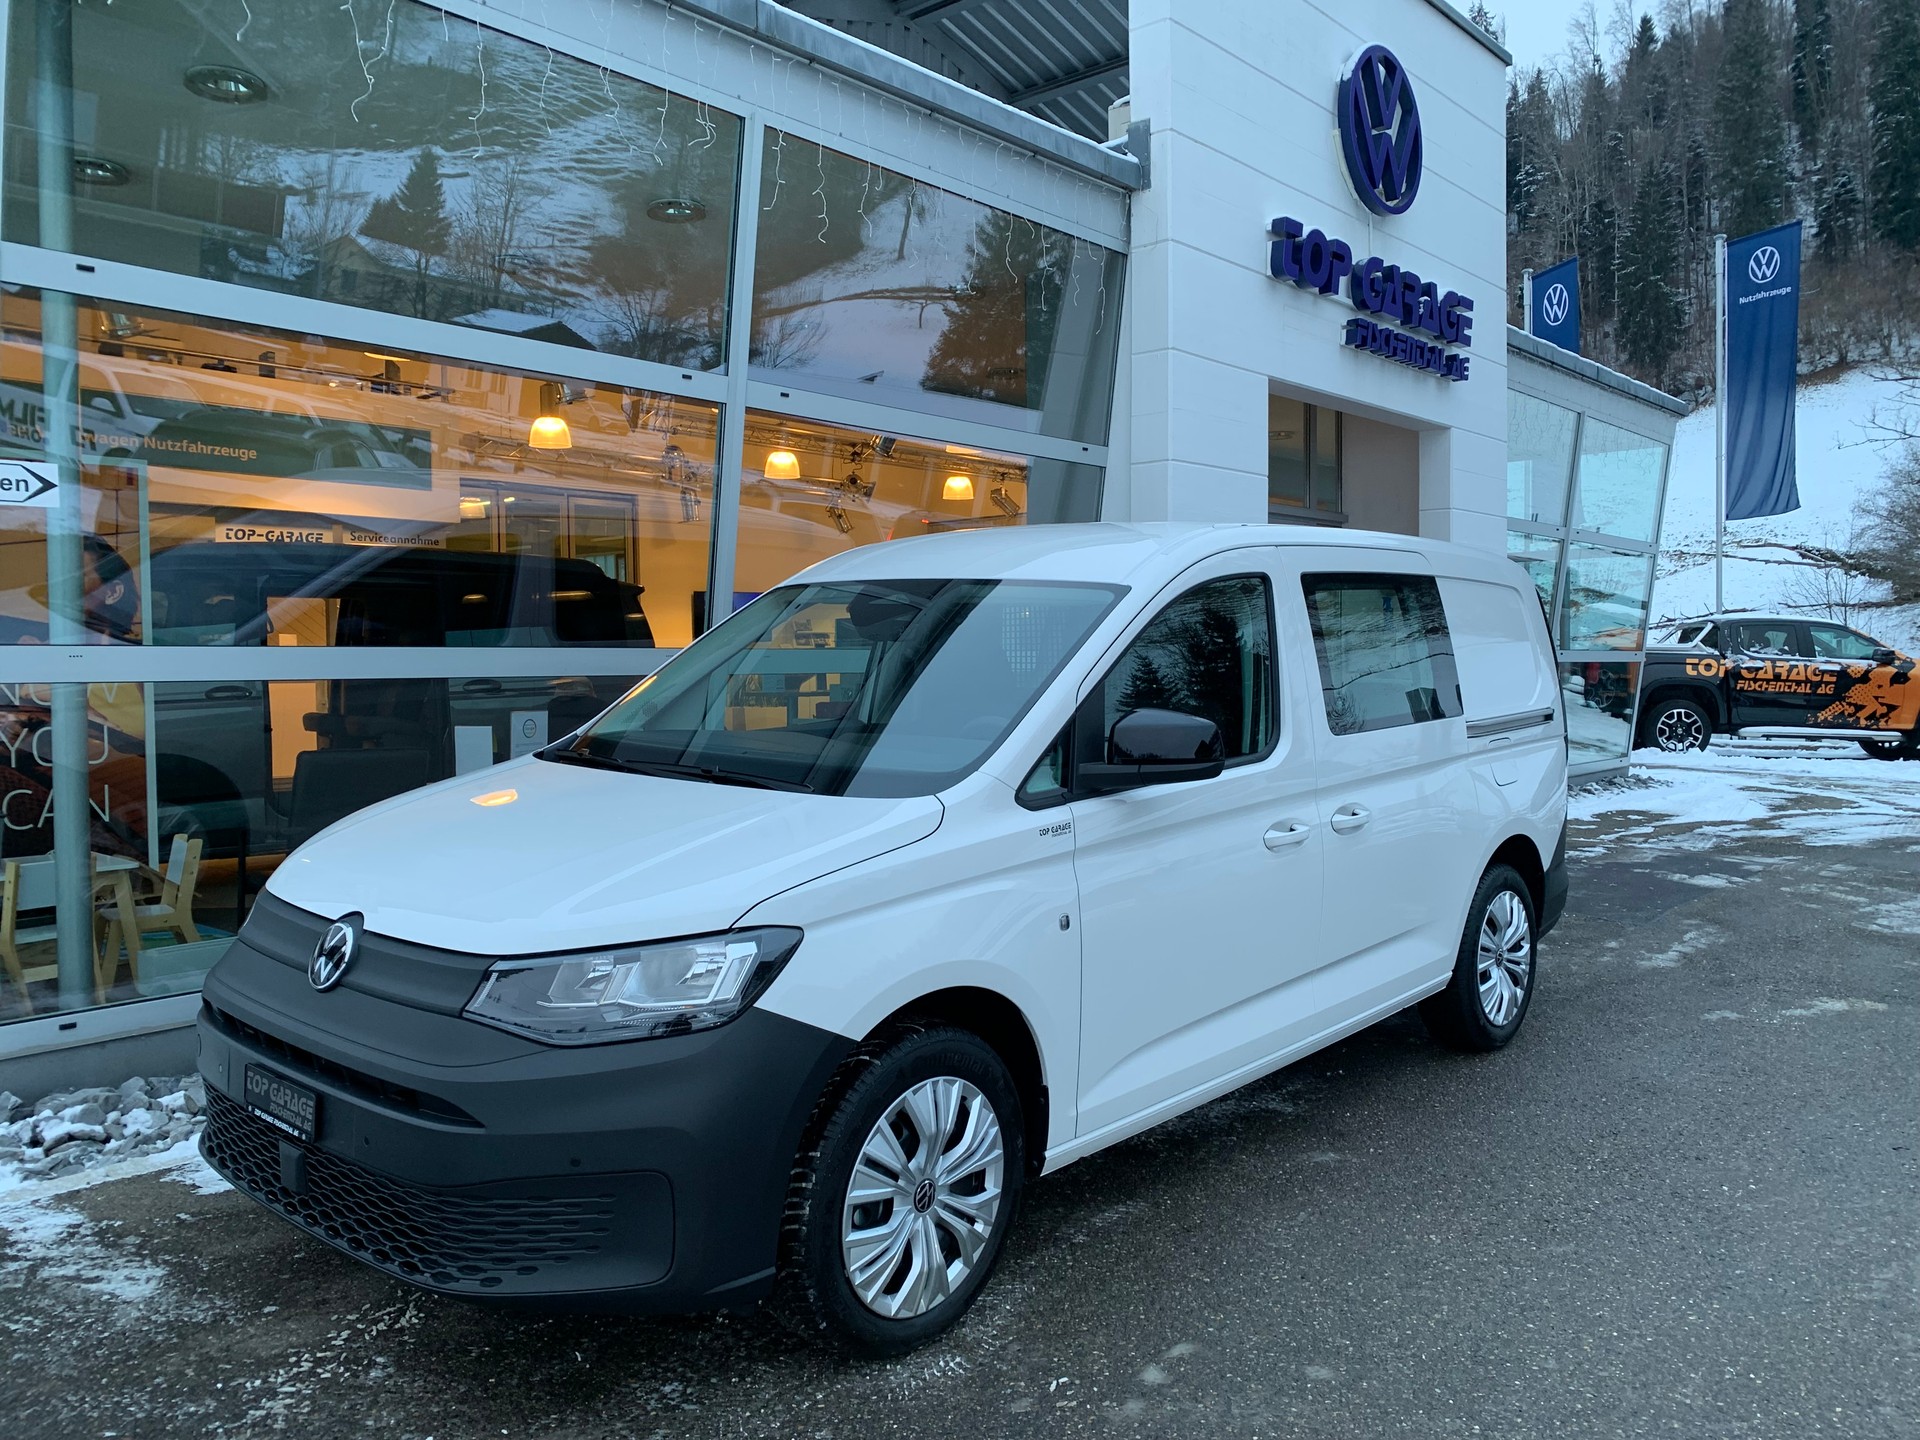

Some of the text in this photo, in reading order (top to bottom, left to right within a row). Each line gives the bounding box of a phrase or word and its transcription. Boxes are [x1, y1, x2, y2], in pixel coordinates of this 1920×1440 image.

[1270, 216, 1475, 347] TOP GARAGE
[143, 436, 257, 461] Nutzfahrzeuge
[350, 531, 440, 546] Serviceannahme
[1736, 680, 1836, 695] FISCHENTHAL AG
[247, 1070, 314, 1121] TOP GARAGE
